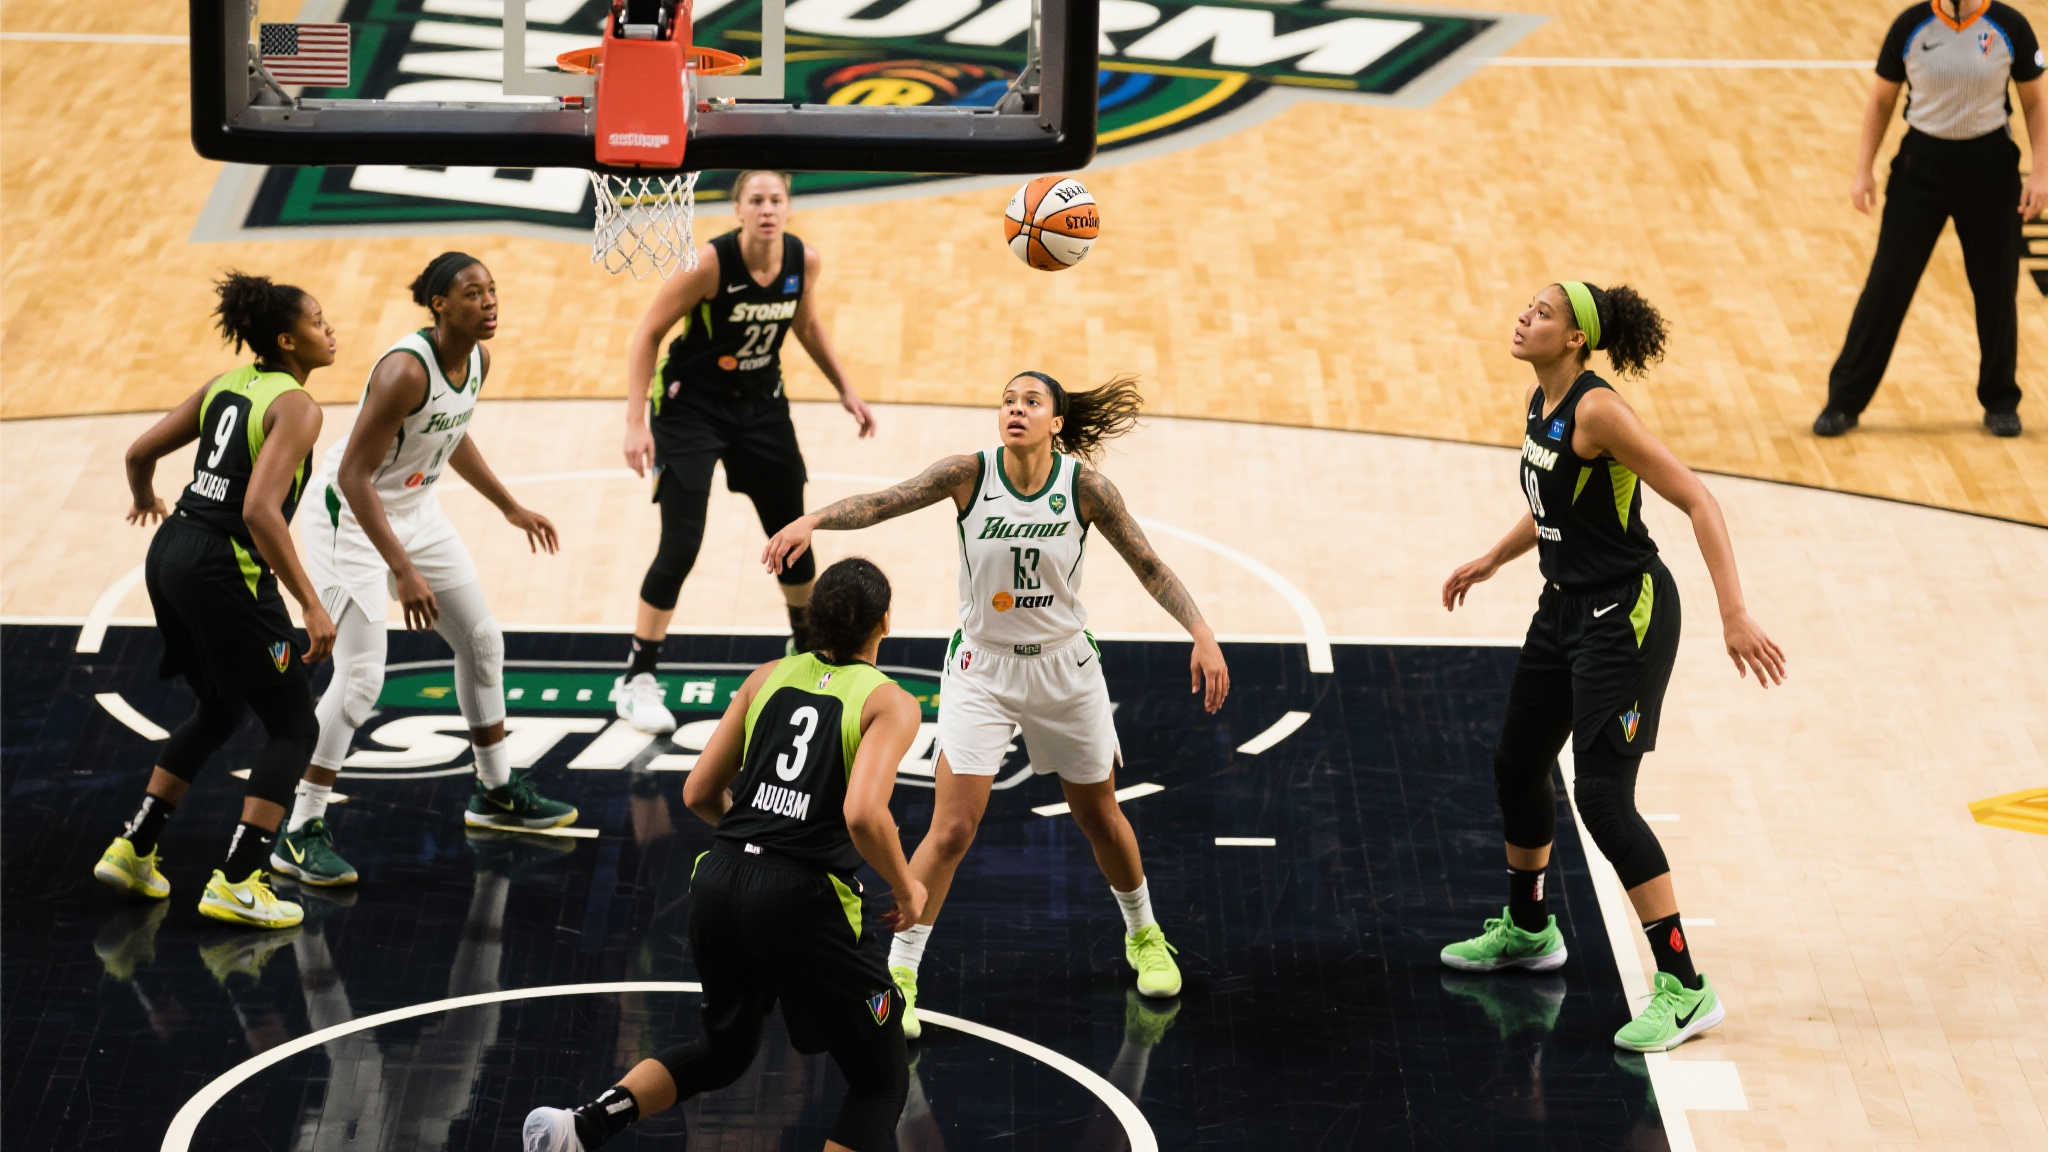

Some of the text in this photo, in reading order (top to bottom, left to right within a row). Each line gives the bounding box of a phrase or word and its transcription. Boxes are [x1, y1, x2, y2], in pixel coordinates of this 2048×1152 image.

[728, 300, 798, 323] STORM
[207, 404, 238, 469] 9
[1521, 433, 1560, 472] TORM
[1010, 546, 1041, 590] 13
[776, 705, 819, 782] 3
